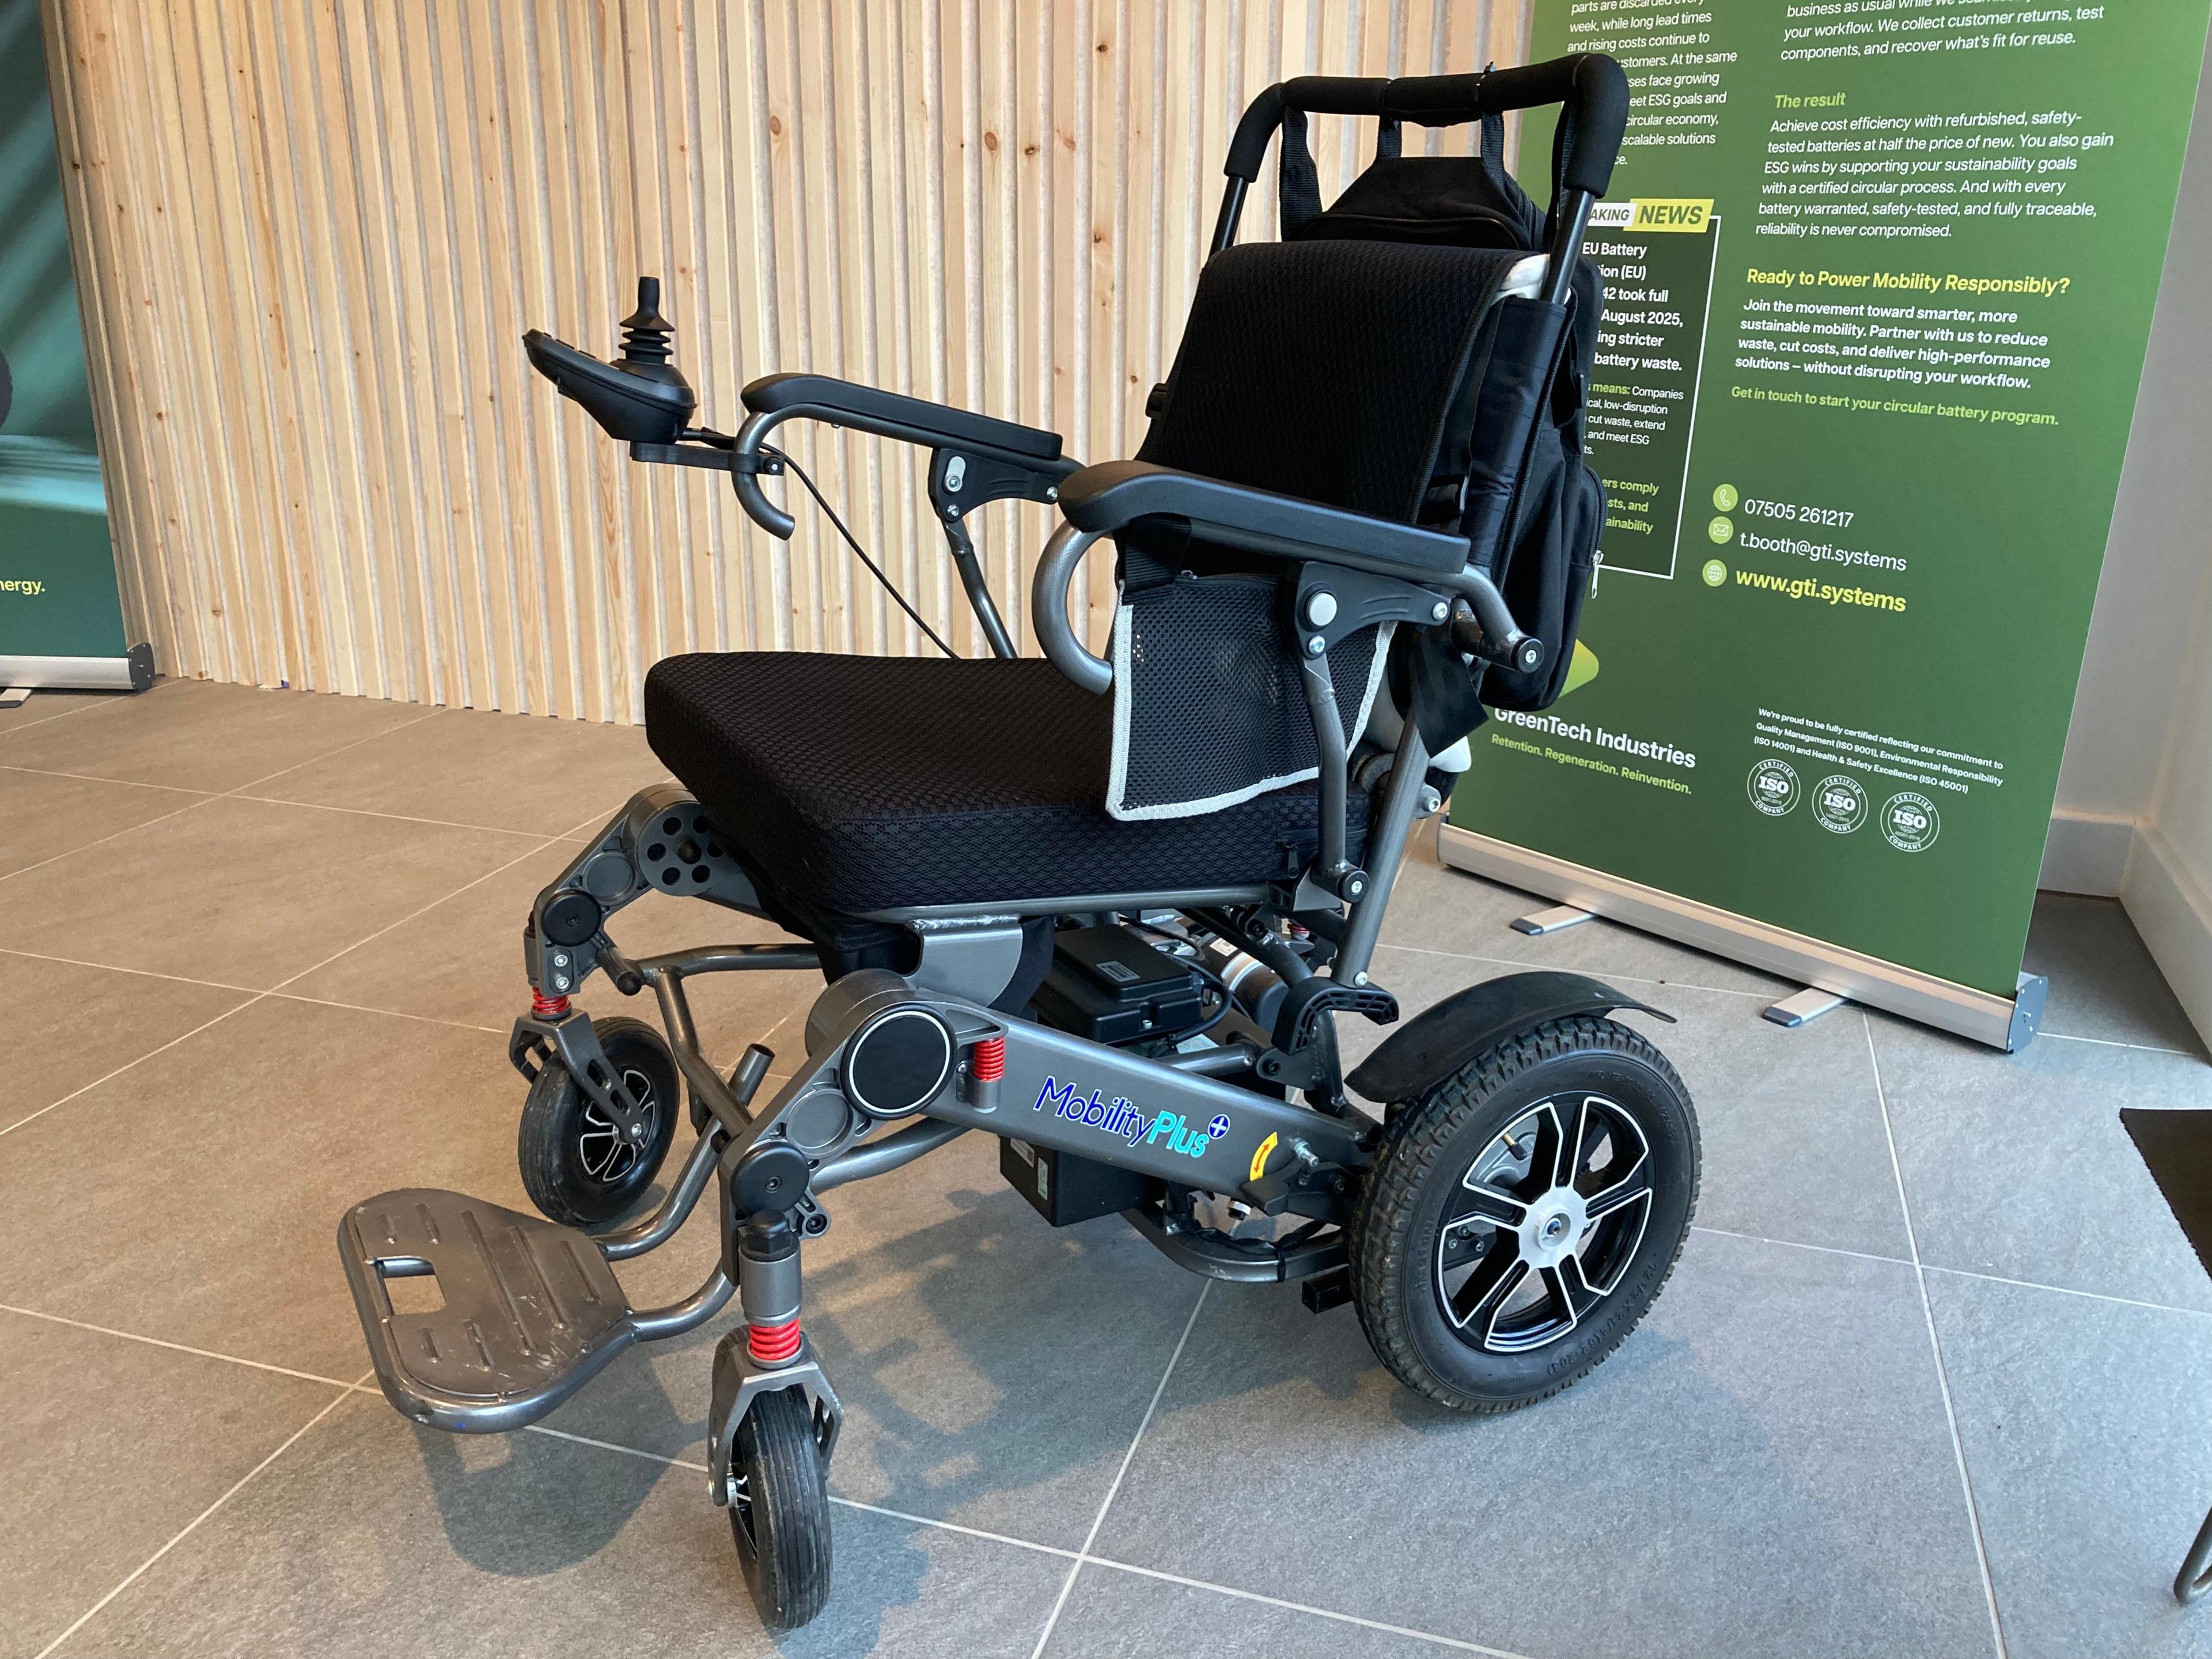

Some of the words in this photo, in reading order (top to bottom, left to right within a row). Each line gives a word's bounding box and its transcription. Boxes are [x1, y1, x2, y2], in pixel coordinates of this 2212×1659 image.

[1571, 2, 1598, 15] parts
[1787, 5, 1840, 17] business
[1861, 0, 1895, 11] usual
[1570, 20, 1599, 33] week,
[1602, 17, 1628, 30] while
[1630, 17, 1654, 30] long
[1656, 13, 1679, 26] lead
[1681, 13, 1712, 24] times
[1783, 27, 1813, 42] your
[1815, 21, 1874, 36] workflow.
[1878, 18, 1899, 32] We
[1902, 16, 1945, 31] collect
[1948, 13, 2015, 28] customer
[2017, 9, 2072, 23] returns,
[2077, 6, 2104, 20] test
[1589, 38, 1616, 52] rising
[1618, 36, 1647, 49] costs
[1649, 34, 1696, 47] continue
[1781, 44, 1861, 61] components,
[1891, 40, 1942, 53] recover
[1946, 35, 1990, 50] what's
[2032, 33, 2075, 45] reuse.
[1617, 56, 1668, 68] stomers.
[1705, 52, 1737, 63] same
[1649, 74, 1672, 86] face
[1674, 72, 1719, 88] growing
[1630, 96, 1647, 107] eet
[1649, 93, 1671, 106] ESG
[1673, 93, 1703, 108] goals
[1775, 94, 1801, 108] The
[1804, 92, 1846, 107] result
[1626, 114, 1664, 126] circular
[1665, 114, 1718, 127] economy,
[1770, 119, 1819, 132] Achieve
[1821, 118, 1848, 131] cost
[1850, 116, 1912, 131] efficiency
[1945, 111, 2028, 127] refurbished,
[2031, 110, 2082, 127] safety-
[1622, 134, 1665, 146] scalable
[1667, 132, 1716, 145] solutions
[1768, 140, 1805, 153] tested
[1806, 138, 1861, 152] batteries
[1878, 137, 1904, 150] half
[1929, 136, 1963, 152] price
[1982, 137, 2014, 148] new.
[2020, 134, 2046, 147] You
[2048, 133, 2079, 147] also
[2081, 132, 2114, 150] gain
[1764, 161, 1789, 173] ESG
[1792, 161, 1820, 173] wins
[1839, 159, 1909, 175] supporting
[1911, 161, 1942, 175] your
[1944, 157, 2036, 173] sustainability
[2037, 156, 2077, 173] goals
[1799, 181, 1849, 194] certified
[1851, 181, 1899, 194] circular
[1900, 183, 1956, 196] process.
[1959, 180, 1990, 193] And
[2025, 182, 2066, 196] every
[1639, 206, 1703, 224] NEWS
[1759, 202, 1802, 217] battery
[1804, 202, 1869, 216] warranted,
[1872, 202, 1960, 218] safety-tested,
[1994, 202, 2023, 218] fully
[2026, 202, 2097, 217] traceable,
[1756, 222, 1808, 238] reliability
[1821, 226, 1858, 236] never
[1859, 224, 1952, 239] compromised.
[1582, 242, 1599, 255] EU
[1601, 243, 1647, 259] Battery
[1621, 265, 1646, 281] (EU)
[1747, 268, 1796, 288] Ready
[1817, 271, 1870, 287] Power
[1872, 272, 1942, 294] Mobility
[1945, 274, 2070, 297] Responsibly?
[1618, 289, 1646, 301] took
[1649, 289, 1669, 302] full
[1601, 309, 1646, 325] August
[1647, 312, 1683, 328] 2025,
[1743, 299, 1770, 311] Join
[1796, 304, 1865, 316] movement
[1867, 305, 1915, 318] toward
[1916, 309, 1975, 323] smarter,
[1978, 312, 2018, 323] more
[1618, 332, 1664, 347] stricter
[1741, 319, 1810, 333] sustainable
[1812, 323, 1866, 339] mobility.
[1869, 325, 1922, 339] Partner
[1995, 332, 2048, 346] reduce
[1594, 352, 1639, 370] battery
[1642, 358, 1682, 371] waste.
[1738, 339, 1777, 352] waste,
[1802, 343, 1839, 357] costs,
[1869, 345, 1916, 359] deliver
[1918, 348, 2050, 368] high-performance
[1735, 357, 1790, 370] solutions
[1804, 361, 1853, 376] without
[1854, 364, 1923, 384] disrupting
[1925, 372, 1958, 384] your
[1960, 373, 2031, 388] workflow.
[1593, 384, 1630, 395] means:
[1632, 386, 1684, 400] Companies
[1604, 399, 1668, 415] low-disruption
[1732, 386, 1752, 399] Get
[1768, 390, 1802, 403] touch
[1819, 395, 1850, 407] start
[1851, 399, 1882, 411] your
[1884, 399, 1935, 414] circular
[1937, 403, 1989, 422] battery
[1991, 411, 2058, 425] program.
[1588, 415, 1603, 424] cut
[1604, 417, 1632, 428] waste,
[1634, 420, 1666, 430] extend
[1606, 433, 1629, 442] meet
[1630, 434, 1649, 445] ESG
[1620, 482, 1659, 496] comply
[1745, 499, 1796, 520] 07505
[1799, 506, 1854, 528] 261217
[1605, 516, 1654, 535] ainability
[1740, 532, 1907, 571] t.booth@gti.systems
[1736, 570, 1906, 612] www.gti.systems
[1495, 708, 1591, 743] GreenTech
[1596, 728, 1696, 768] Industries
[1759, 708, 1781, 719] We're
[1781, 715, 1805, 725] proud
[1826, 723, 1843, 735] fully
[1844, 729, 1878, 742] certified
[1879, 737, 1919, 752] reflecting
[1936, 749, 1993, 767] commitment
[1756, 722, 1783, 736] Quality
[1784, 728, 1835, 747] Management
[1836, 740, 1853, 751] (ISO
[1880, 750, 1941, 771] Environmental
[1942, 764, 2003, 787] Responsibility
[1492, 734, 1543, 756] Retention.
[1545, 747, 1619, 775] Regeneration.
[1621, 767, 1691, 794] Reinvention.
[1754, 736, 1770, 746] (ISO
[1771, 740, 1796, 753] 14001)
[1812, 749, 1838, 762] Health
[1846, 757, 1873, 772] Safety
[1873, 764, 1918, 781] Excellence
[1919, 774, 1938, 785] (ISO
[1938, 779, 1968, 794] 45001)
[1759, 761, 1794, 777] CERTIFIED
[1758, 775, 1789, 794] ISO
[1825, 777, 1861, 794] CERTIFIED
[1756, 800, 1784, 814] COMPANY
[1824, 792, 1856, 811] ISO
[1893, 794, 1932, 811] CERTIFIED
[1820, 817, 1851, 831] COMPANY
[1893, 809, 1927, 829] ISO
[1889, 835, 1921, 850] COMPANY
[1033, 1075, 1209, 1158] MobilityPlus
